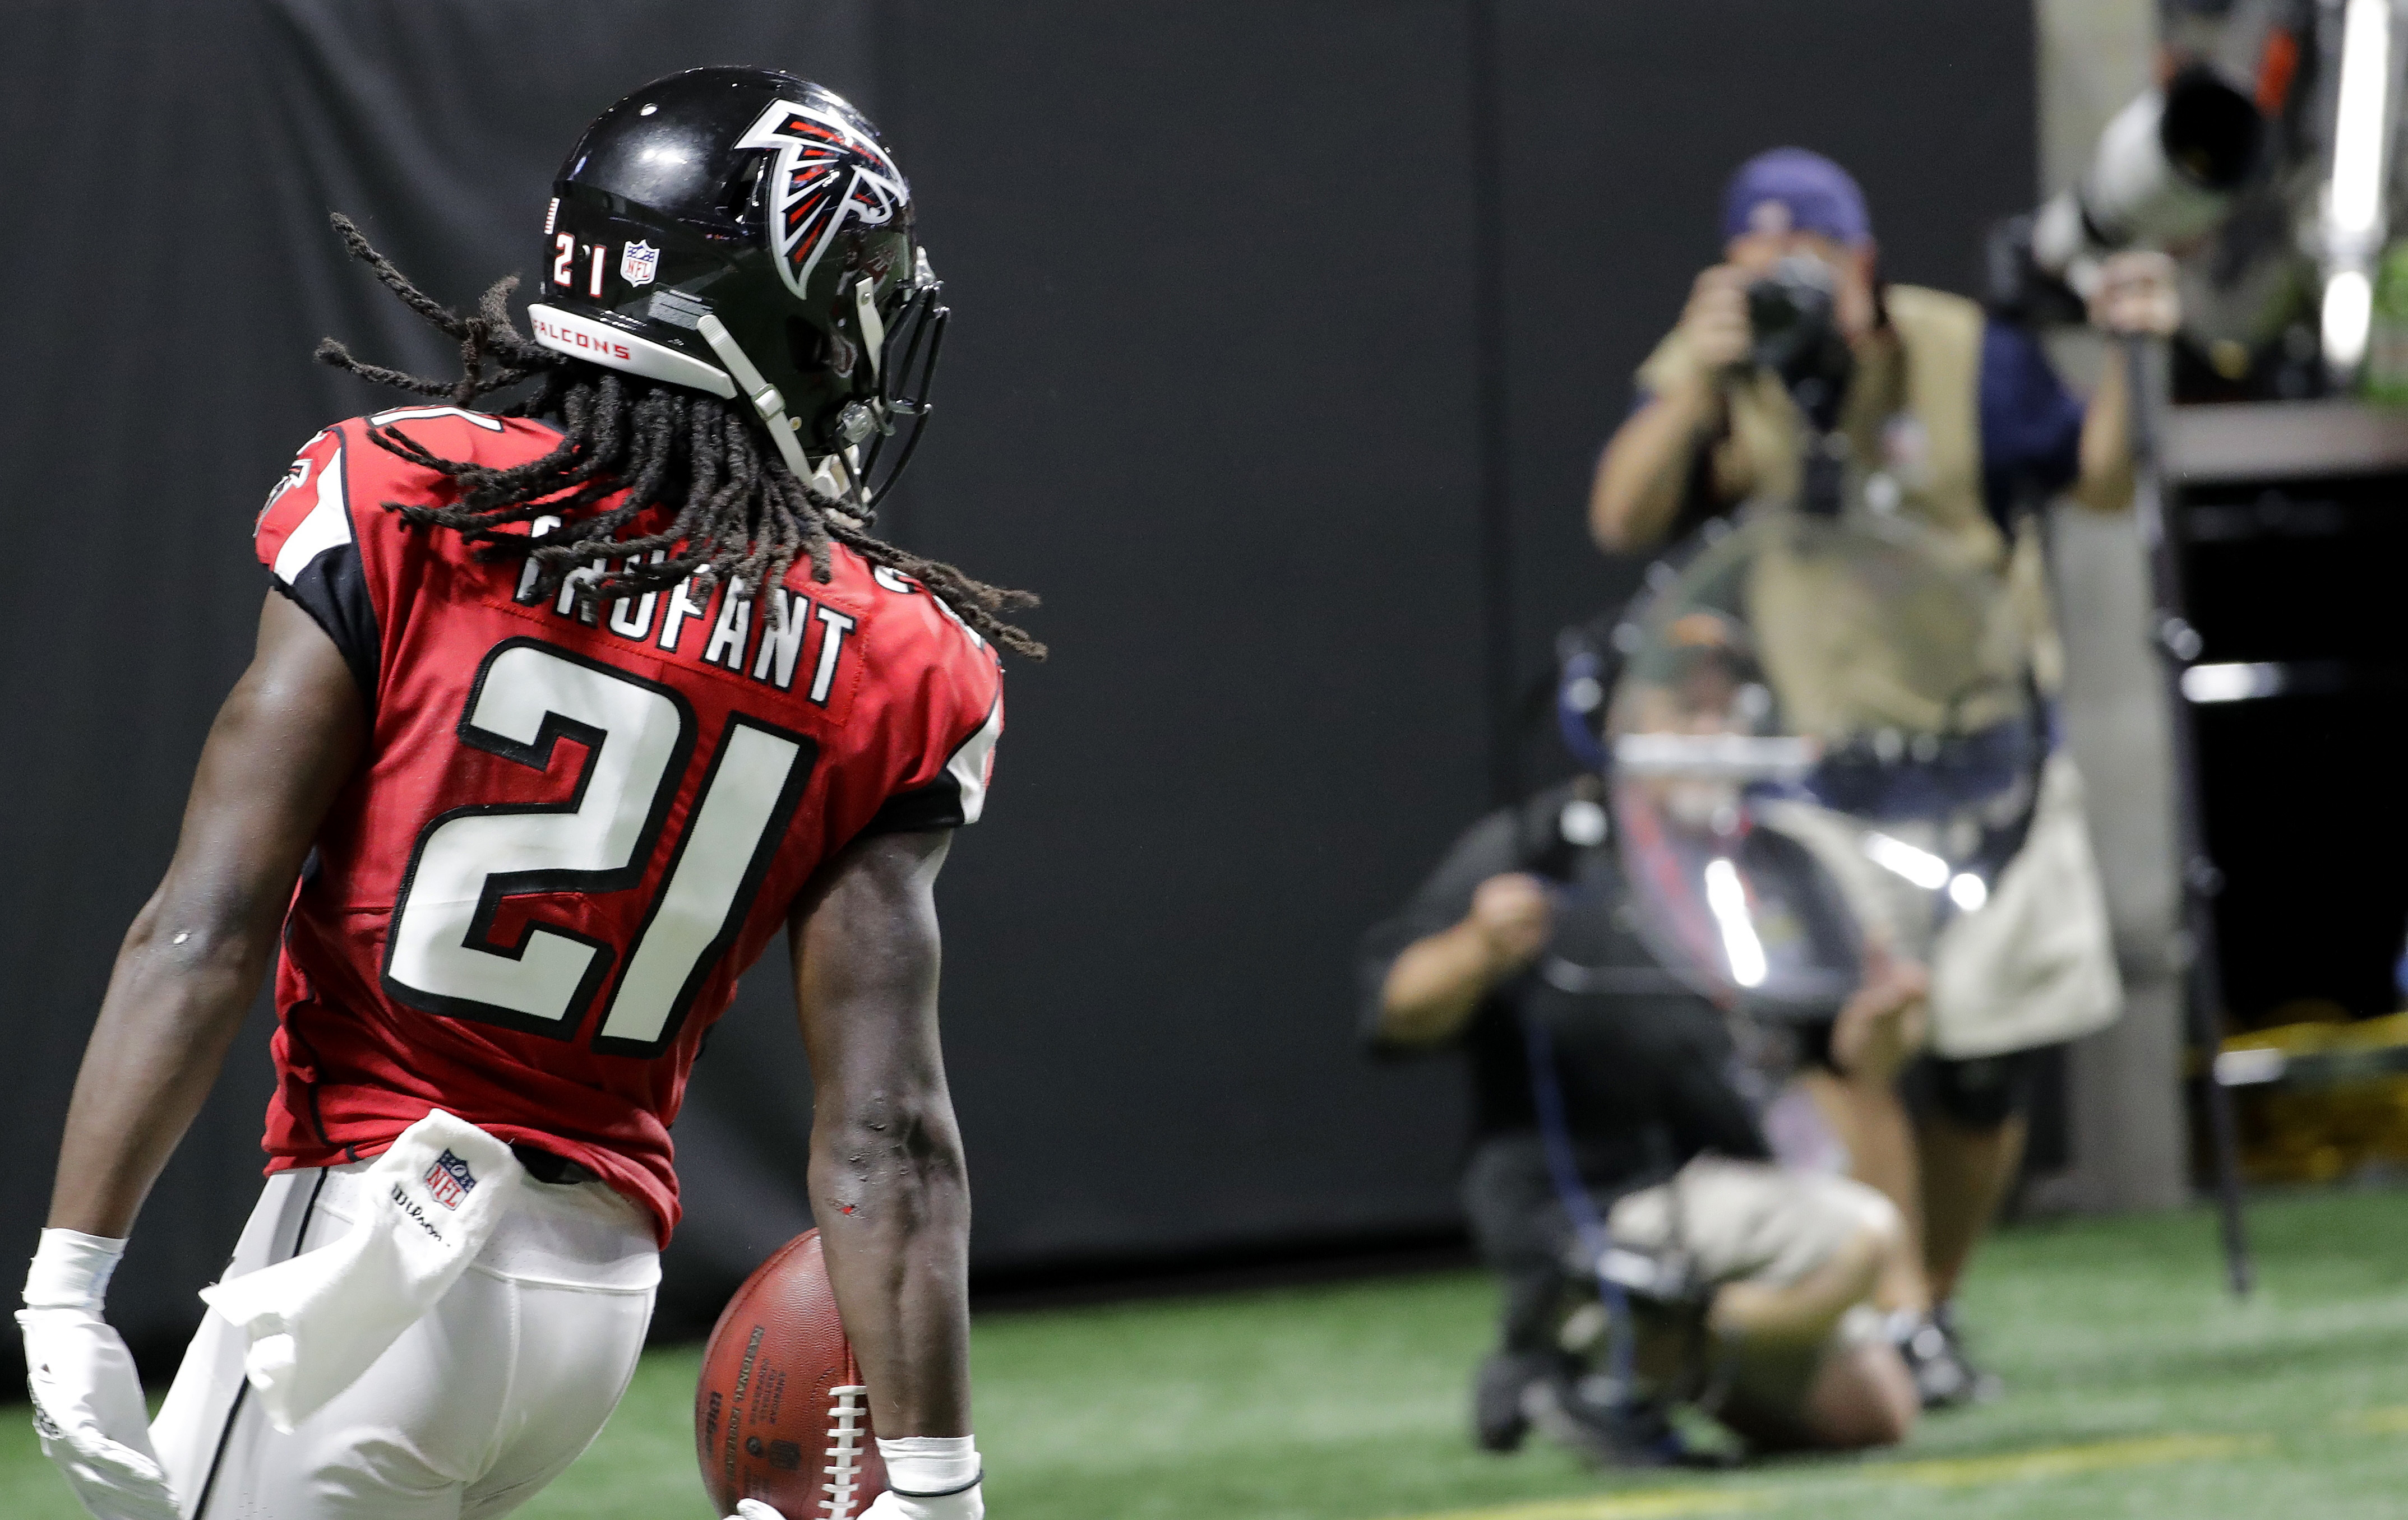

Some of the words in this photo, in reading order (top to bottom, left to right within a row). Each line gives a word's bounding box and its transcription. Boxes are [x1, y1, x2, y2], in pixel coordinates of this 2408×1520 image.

[553, 231, 607, 298] 21
[626, 258, 651, 279] NFL
[380, 635, 819, 1058] 21
[426, 1165, 461, 1207] NFL
